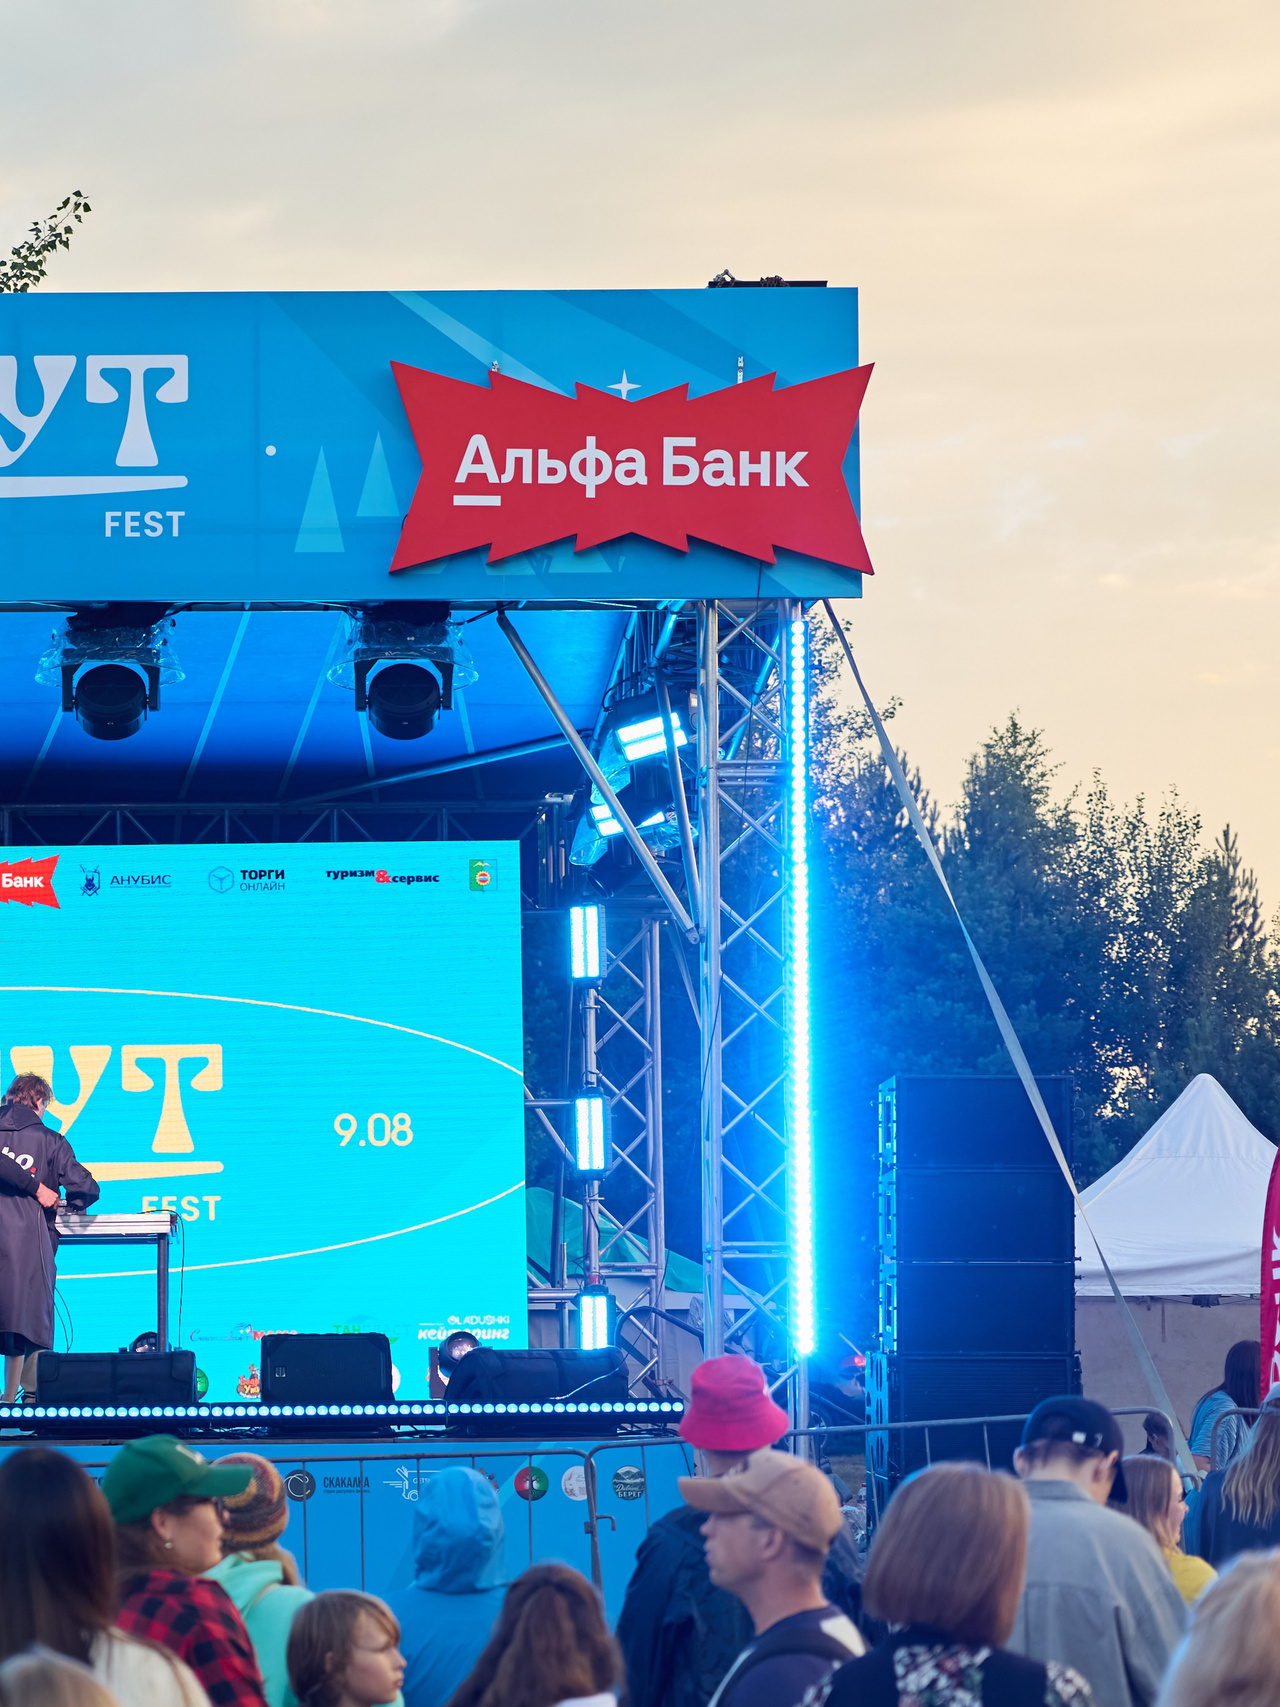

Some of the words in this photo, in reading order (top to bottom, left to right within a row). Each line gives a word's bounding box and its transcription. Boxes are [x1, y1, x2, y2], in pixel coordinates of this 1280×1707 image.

[454, 434, 648, 505] Альфа
[663, 436, 810, 487] Банк
[105, 511, 186, 538] FEST
[1, 873, 45, 888] Банк
[109, 875, 172, 885] АНУБИС
[240, 869, 286, 880] ТОРГИ
[239, 881, 286, 891] ОНЛАЙН
[333, 1112, 414, 1147] 9.08
[417, 1327, 510, 1340] кейринг
